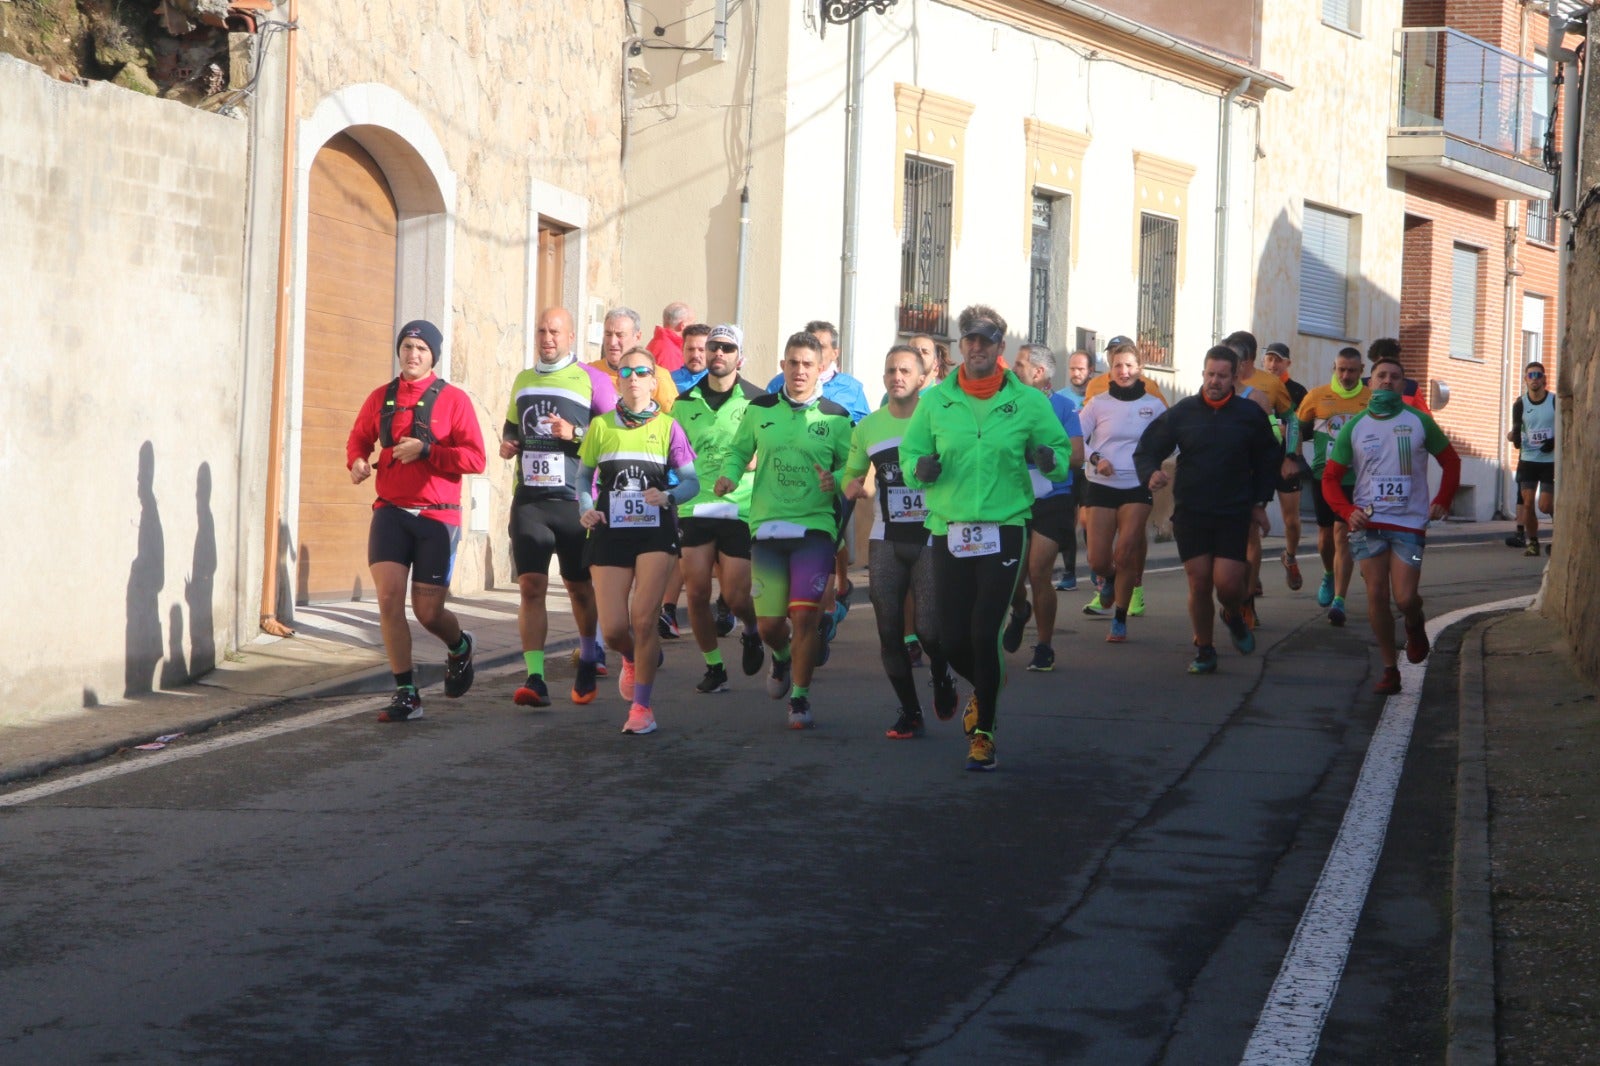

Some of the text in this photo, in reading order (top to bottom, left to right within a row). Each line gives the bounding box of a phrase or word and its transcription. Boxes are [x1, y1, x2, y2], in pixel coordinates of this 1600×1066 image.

[1532, 432, 1548, 441] 494
[532, 460, 550, 475] 98
[1378, 483, 1404, 496] 124
[624, 499, 645, 515] 95
[902, 495, 923, 510] 94
[961, 526, 984, 544] 93
